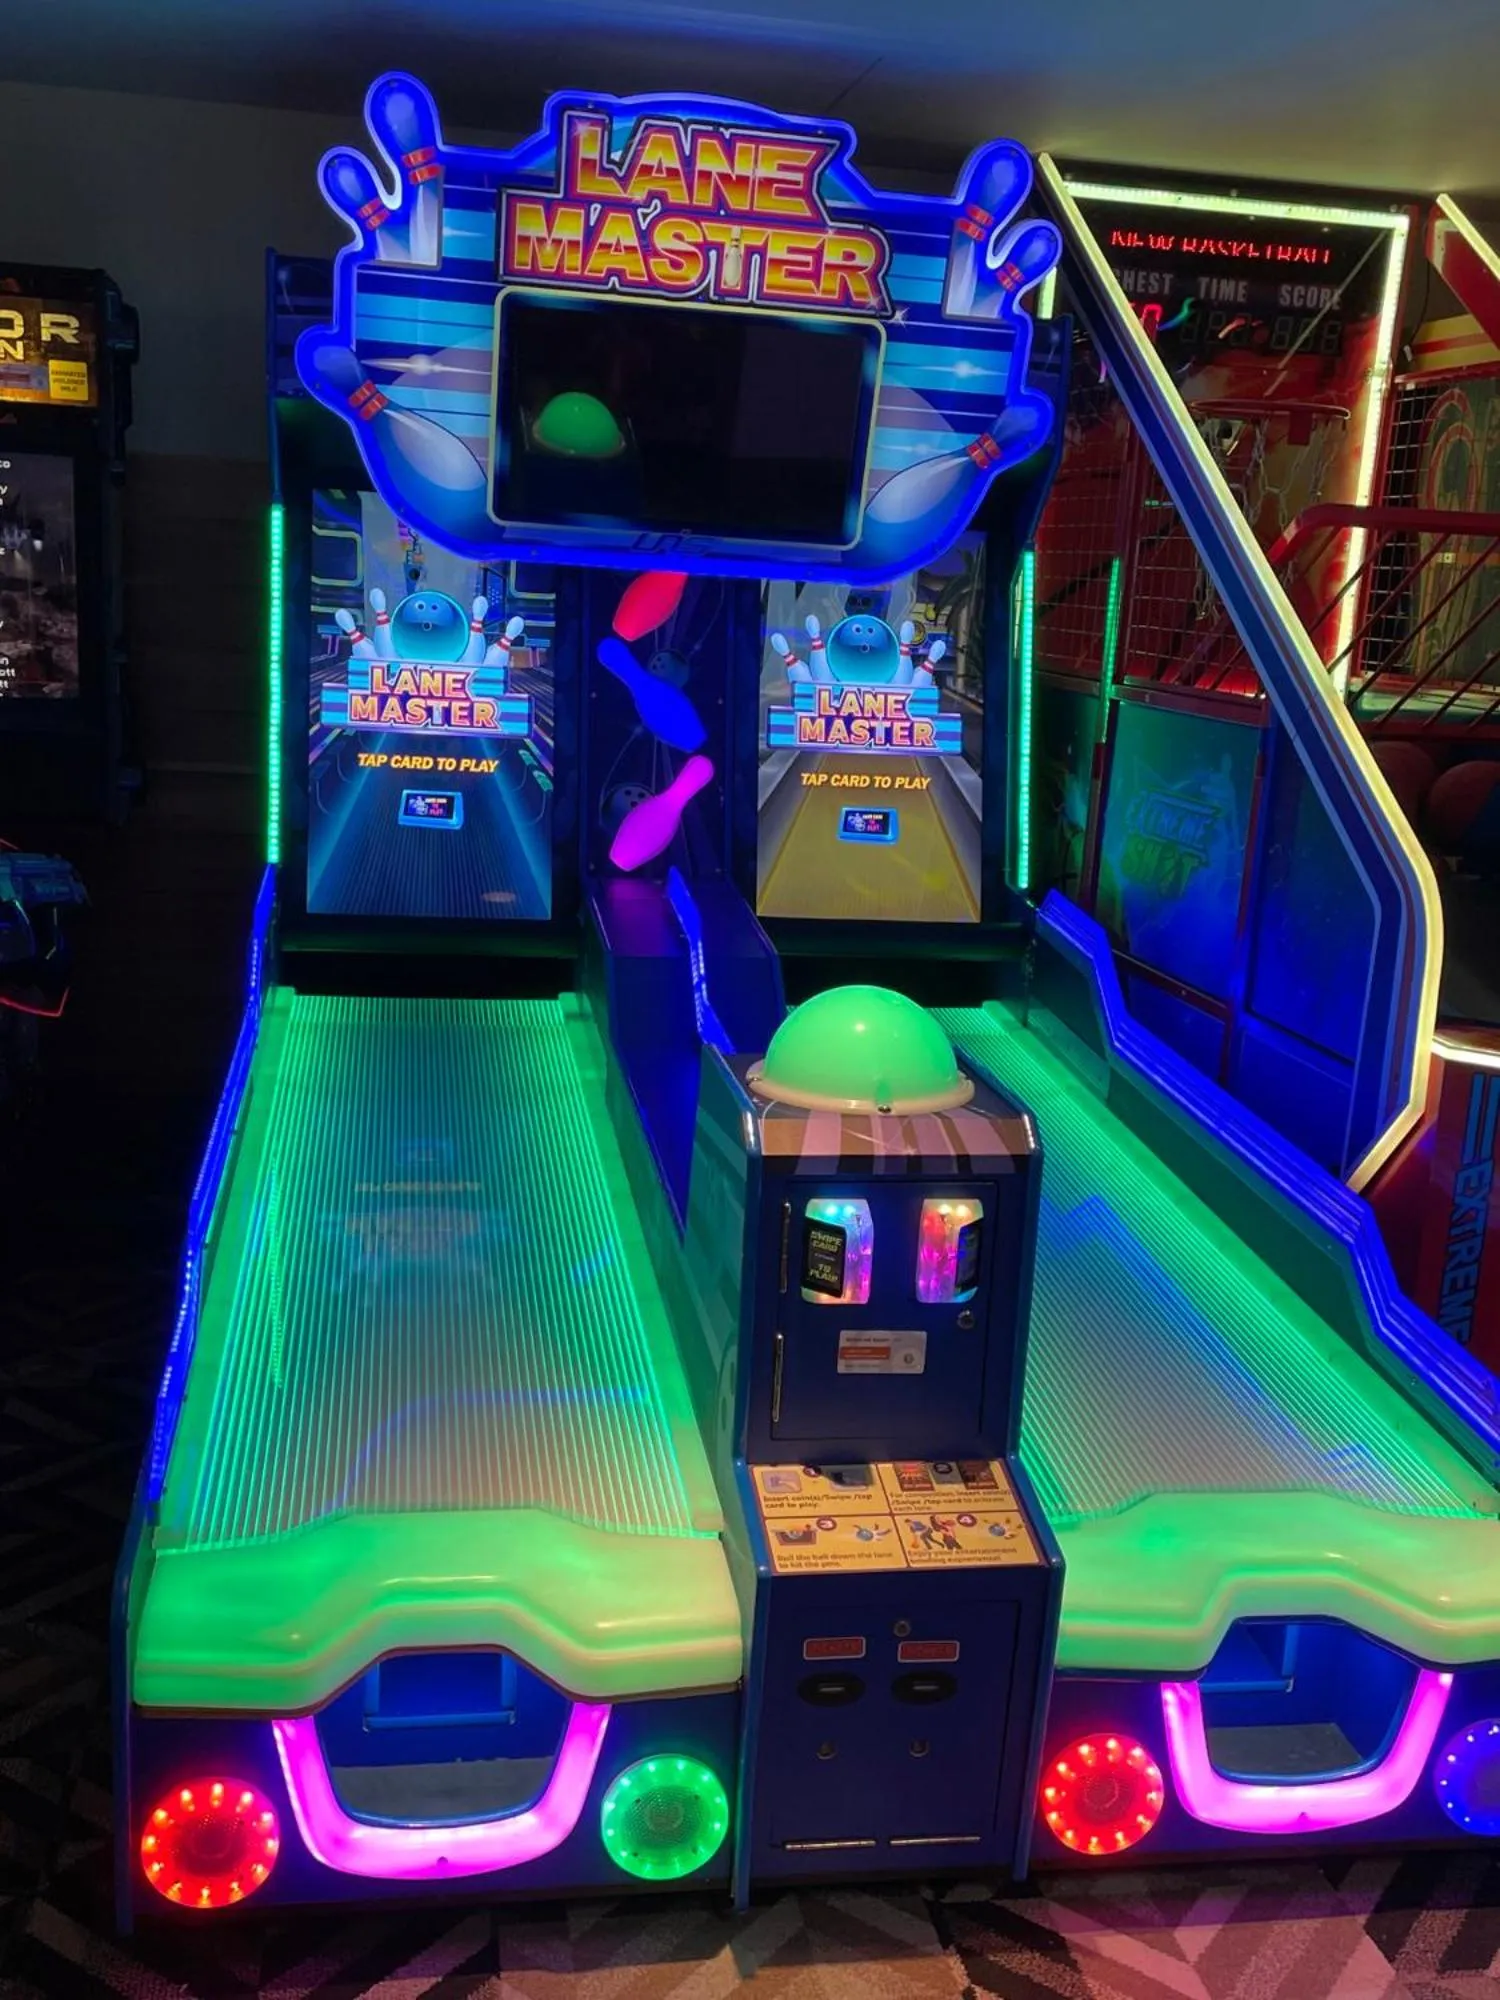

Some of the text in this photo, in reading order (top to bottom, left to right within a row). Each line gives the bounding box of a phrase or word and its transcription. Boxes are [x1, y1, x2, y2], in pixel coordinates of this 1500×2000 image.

[573, 120, 822, 218] LANE
[511, 201, 880, 303] MASTER
[1114, 267, 1341, 310] HEST TIME SCORE
[370, 667, 468, 697] LANE
[350, 694, 498, 728] MASTER
[818, 688, 909, 718] LANE
[799, 717, 935, 746] MASTER
[357, 753, 499, 773] TAP CARD TO PLAY
[801, 772, 931, 790] TAP CARD TO PLAY
